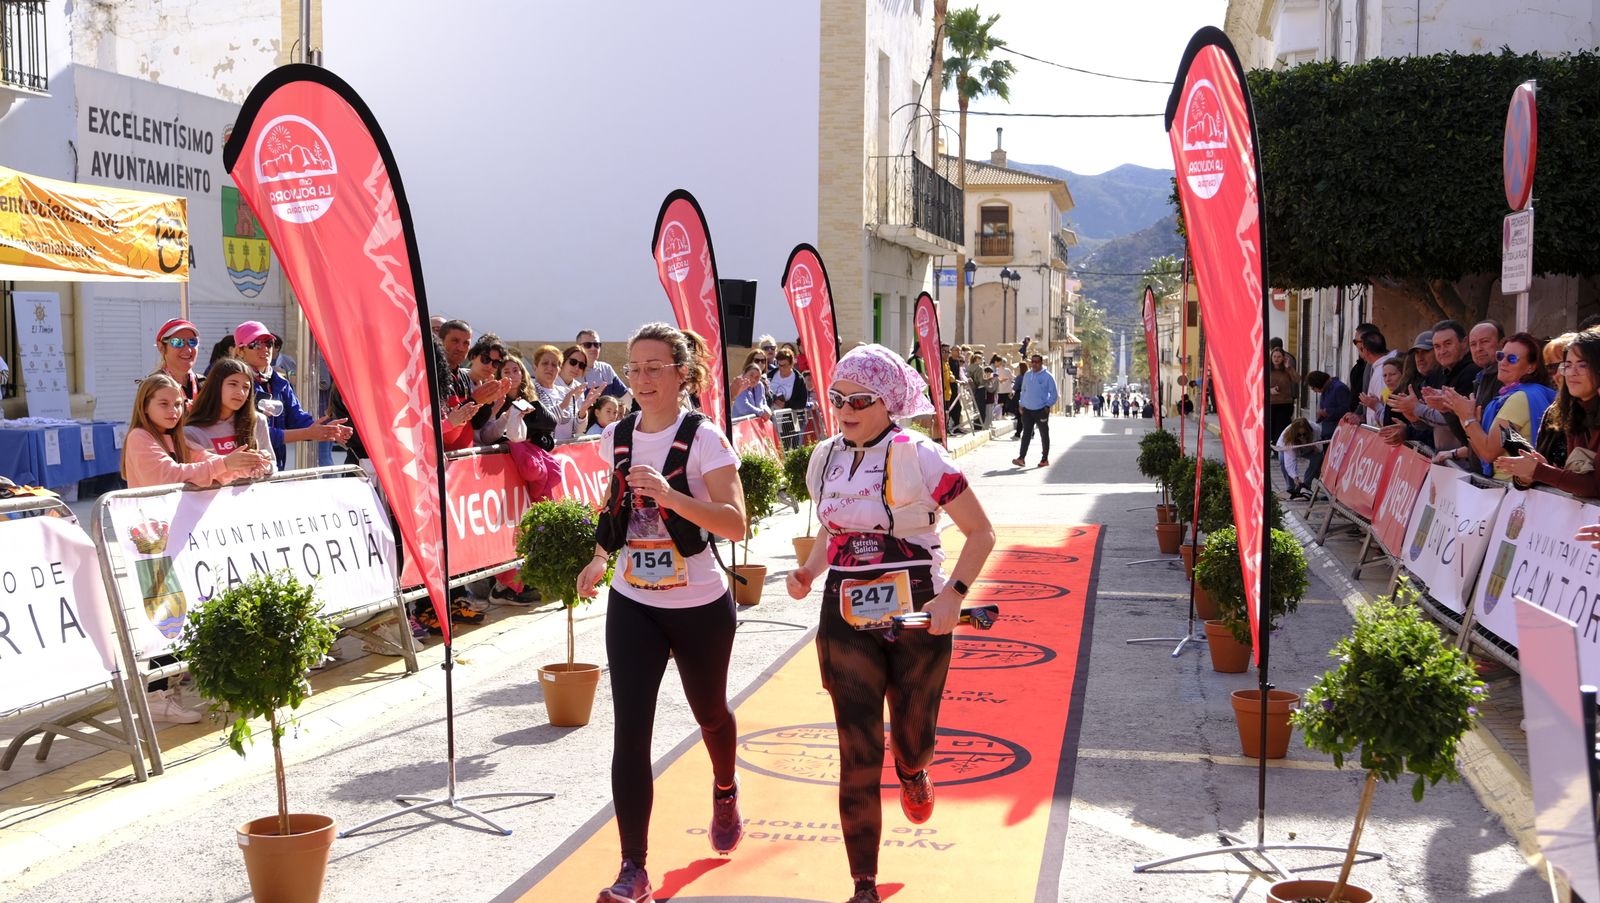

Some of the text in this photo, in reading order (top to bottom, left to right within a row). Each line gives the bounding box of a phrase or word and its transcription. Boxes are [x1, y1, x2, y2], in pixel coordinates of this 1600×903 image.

[88, 106, 213, 155] EXCELENTÍSIMO
[91, 150, 210, 193] AYUNTAMIENTO
[189, 508, 373, 551] AYUNTAMIENTO DE
[852, 539, 878, 548] Estrella
[854, 546, 879, 555] Galicia
[195, 533, 384, 600] CANTORIA
[632, 551, 672, 568] 154
[31, 562, 65, 588] DE
[851, 585, 894, 607] 247
[891, 827, 938, 837] de
